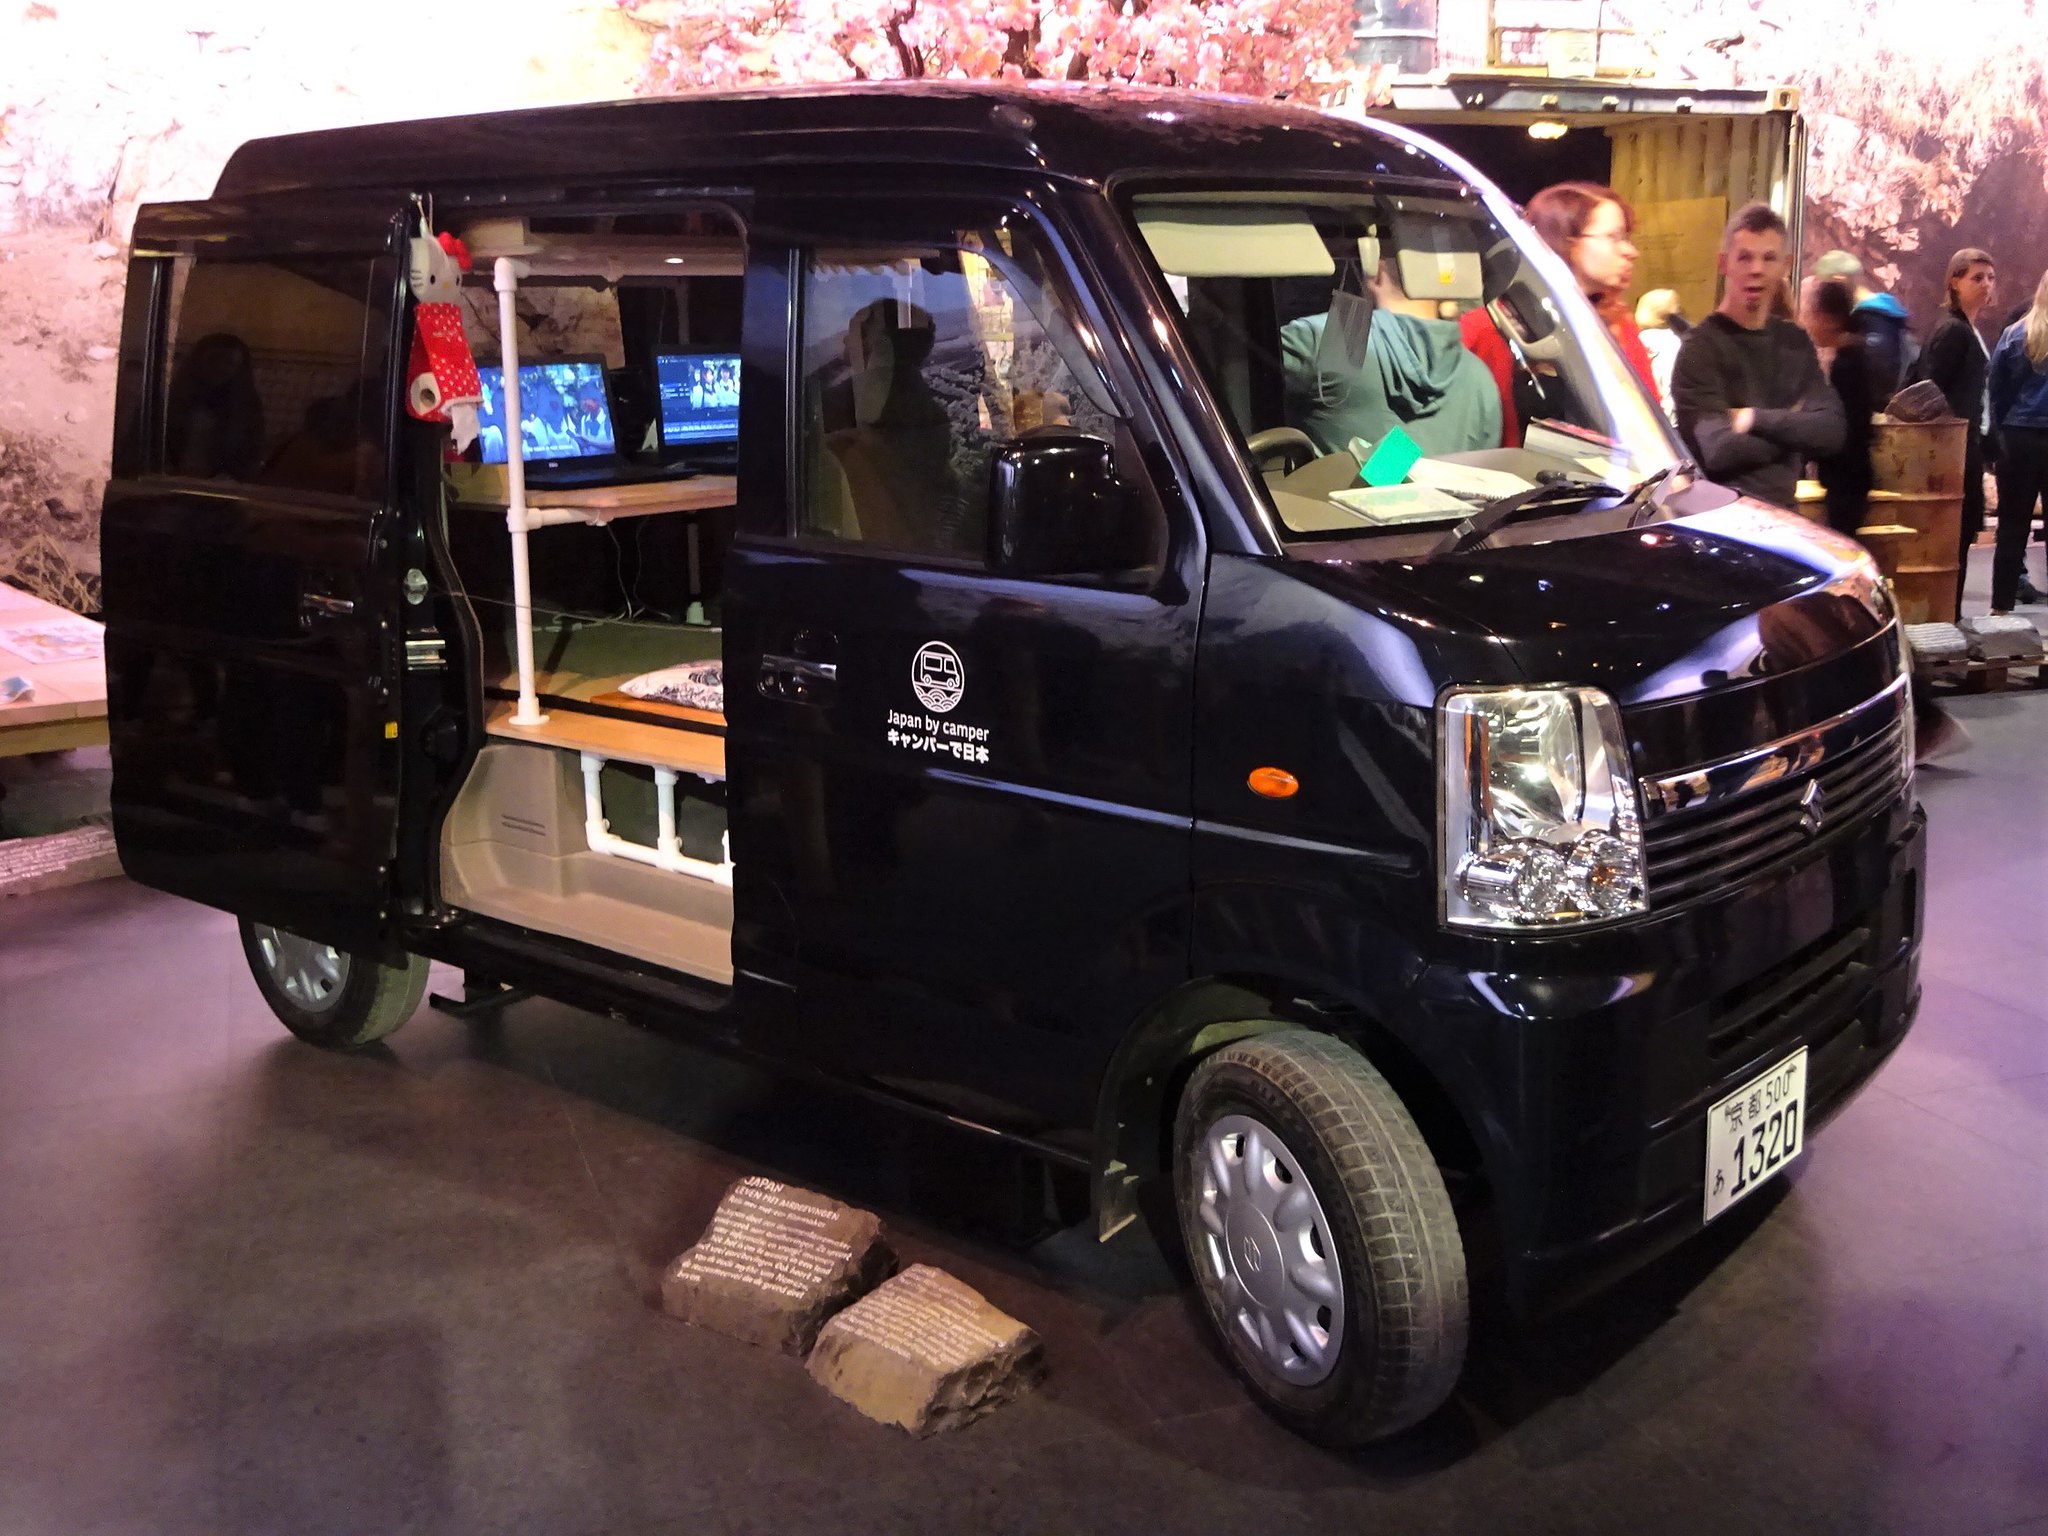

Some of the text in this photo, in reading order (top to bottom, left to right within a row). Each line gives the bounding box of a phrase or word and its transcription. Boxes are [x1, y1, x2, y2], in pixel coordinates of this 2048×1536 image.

[887, 709, 990, 741] Japan by camper
[1728, 1069, 1792, 1132] 京都 500
[1713, 1099, 1798, 1197] あ 1320
[744, 1176, 785, 1193] JAPAN
